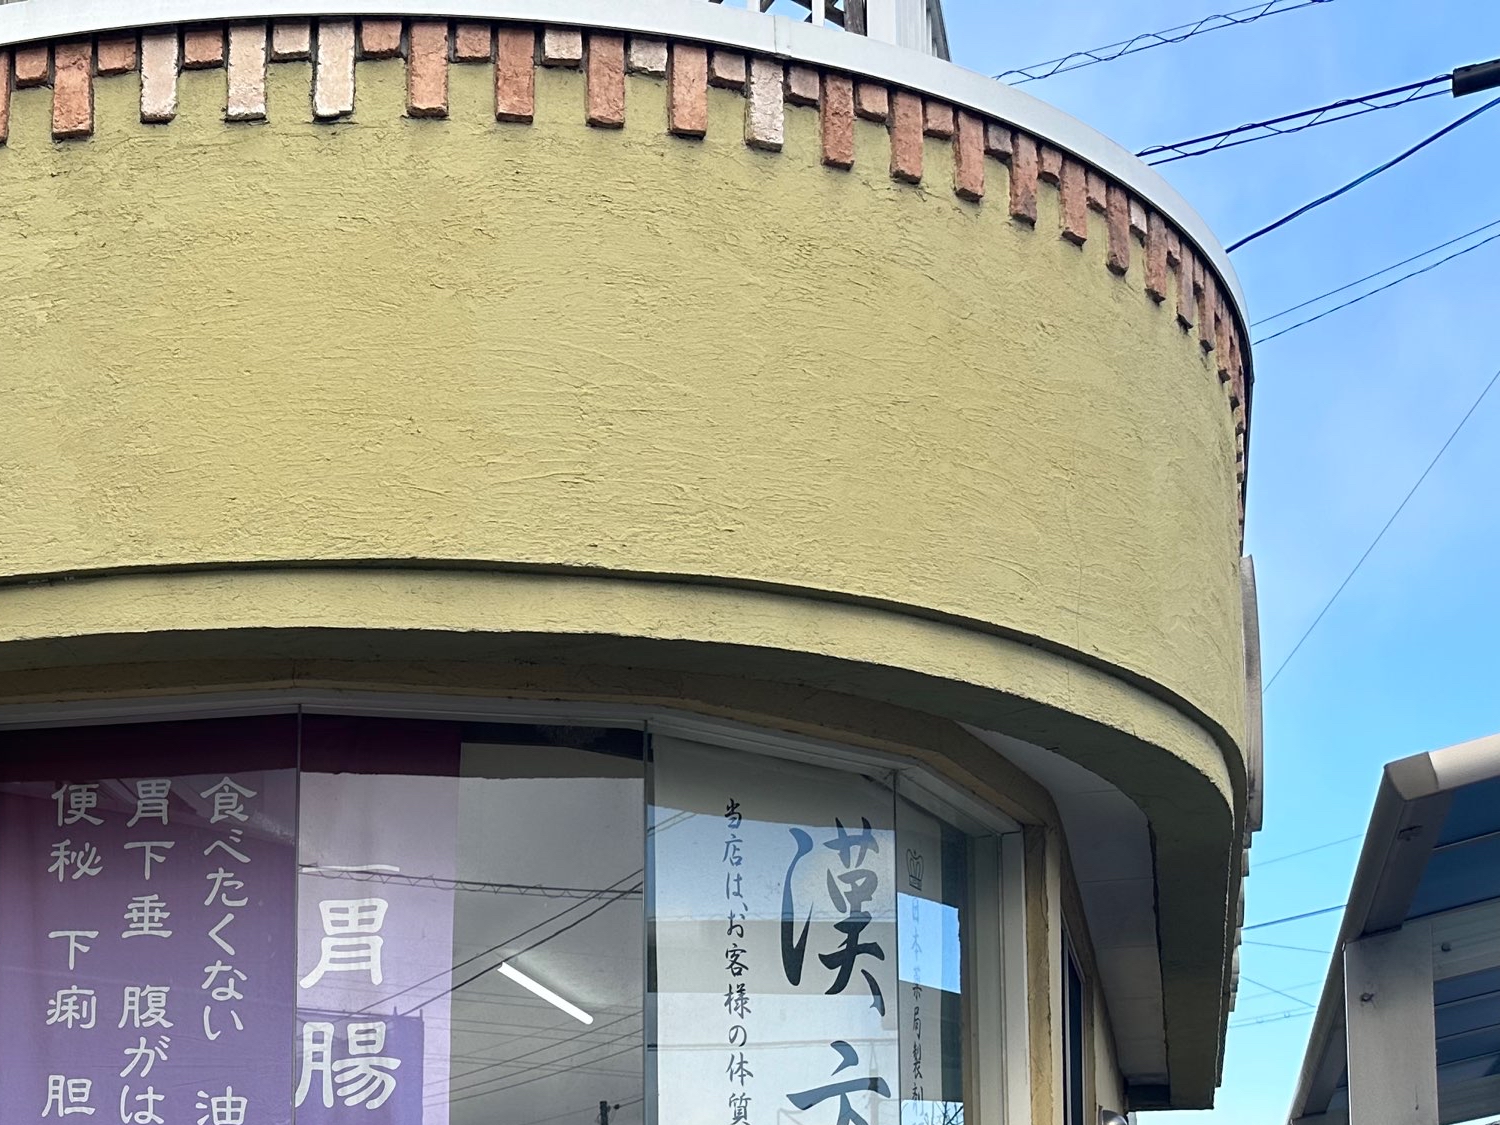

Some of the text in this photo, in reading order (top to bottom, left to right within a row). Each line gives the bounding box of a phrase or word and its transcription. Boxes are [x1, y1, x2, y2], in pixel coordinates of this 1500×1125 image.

[48, 782, 105, 883] 便秘
[121, 779, 175, 939] 胃下垂
[200, 776, 258, 1042] 食べたくない
[46, 929, 99, 1030] 下痢
